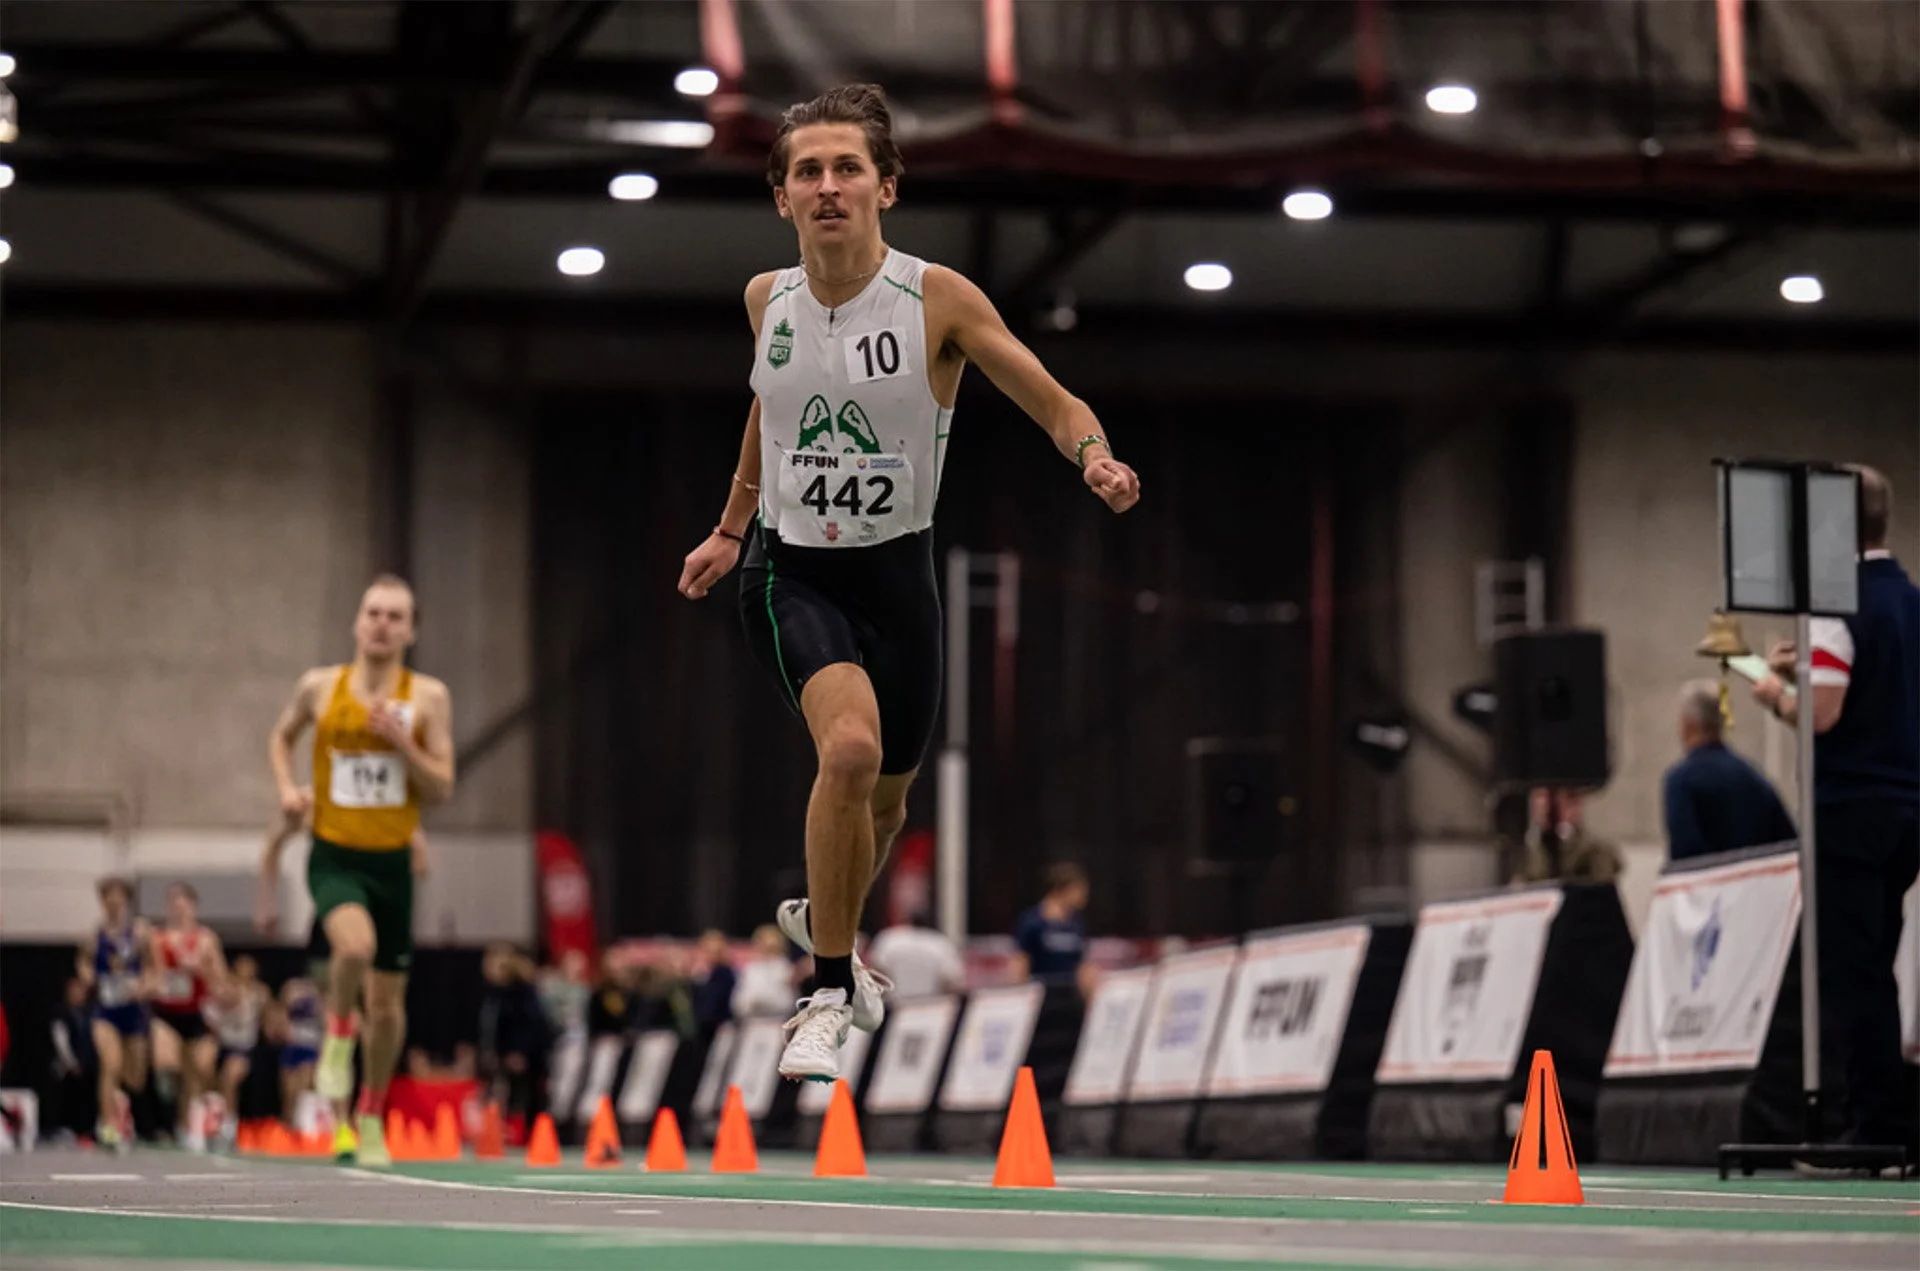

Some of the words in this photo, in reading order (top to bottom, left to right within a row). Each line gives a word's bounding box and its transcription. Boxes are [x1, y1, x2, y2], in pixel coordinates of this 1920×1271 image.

[856, 331, 899, 378] 10
[792, 455, 839, 468] FFUN
[801, 475, 893, 516] 442
